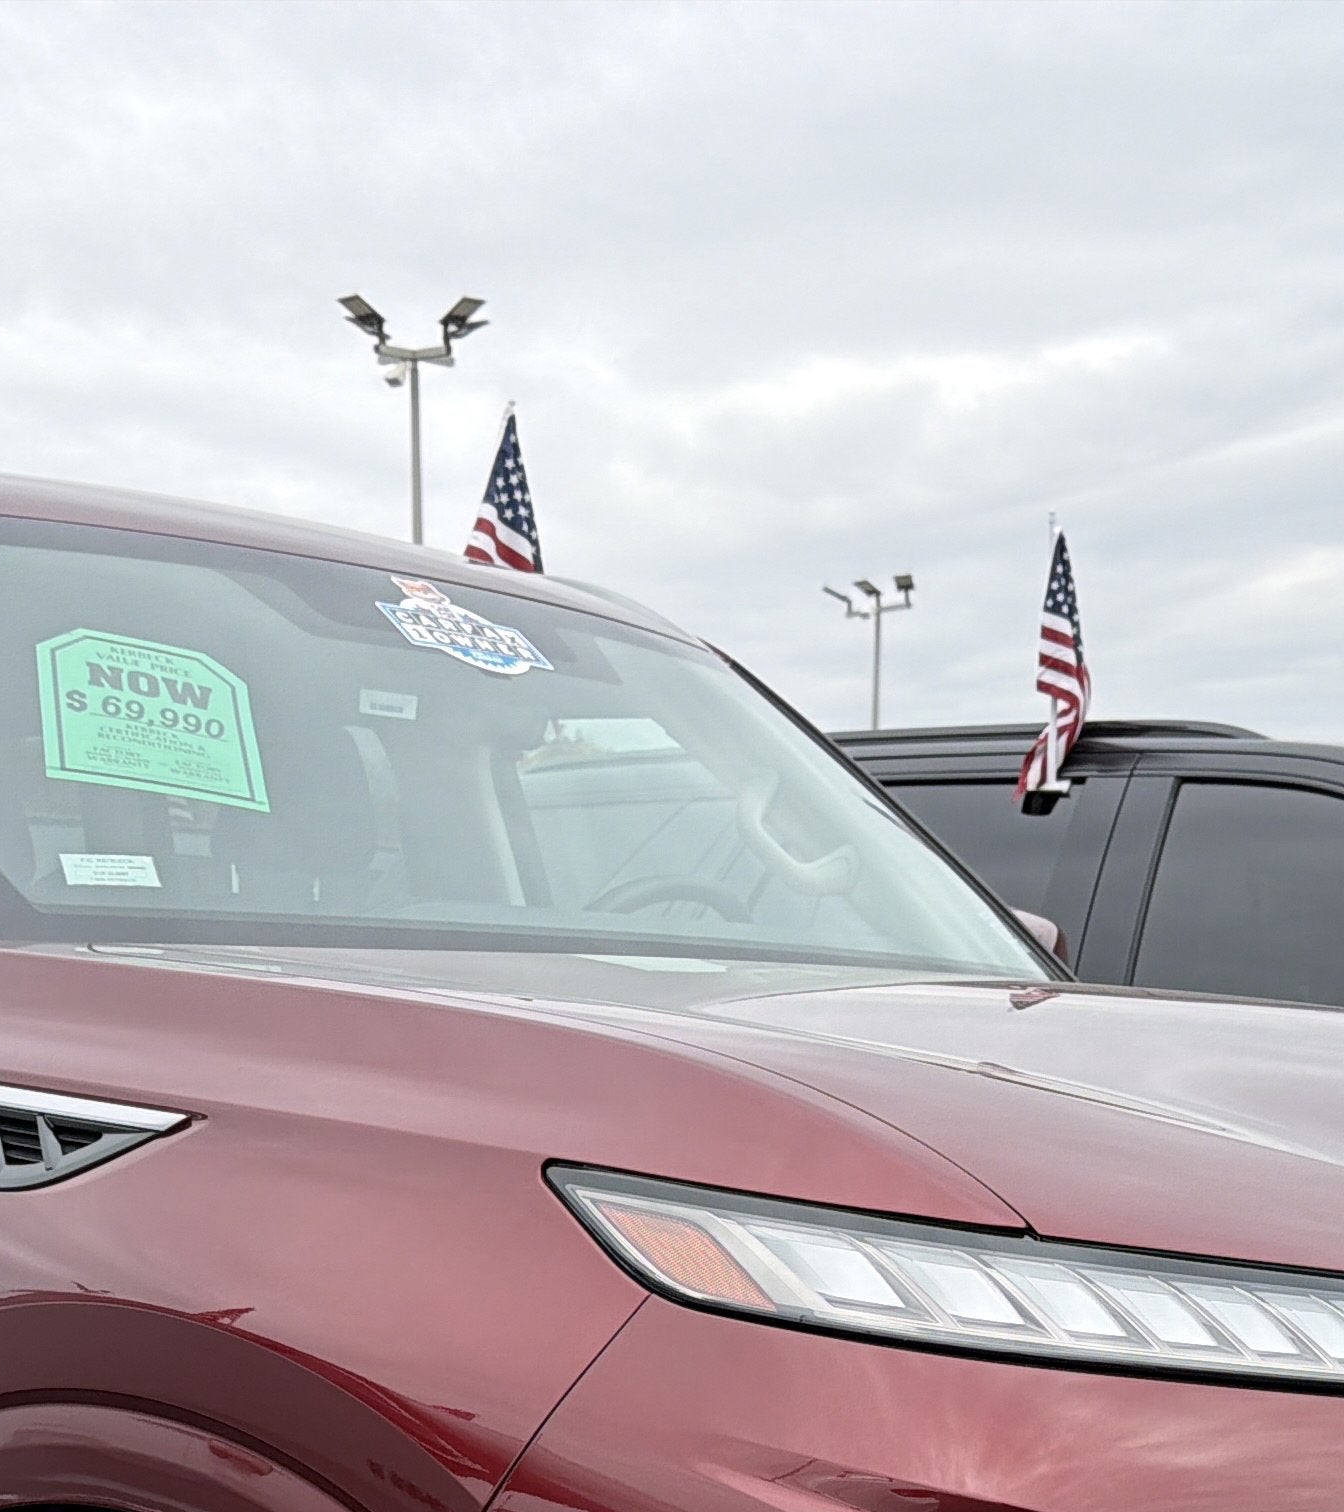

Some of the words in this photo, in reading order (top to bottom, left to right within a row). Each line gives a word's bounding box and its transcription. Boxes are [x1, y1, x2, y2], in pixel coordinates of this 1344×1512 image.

[395, 610, 526, 648] CARFAX
[95, 651, 139, 667] VALUE
[150, 662, 190, 678] PRICE
[110, 646, 174, 664] KERBECK
[86, 661, 212, 710] NOW
[65, 689, 88, 712] $
[101, 695, 225, 739] 69,990
